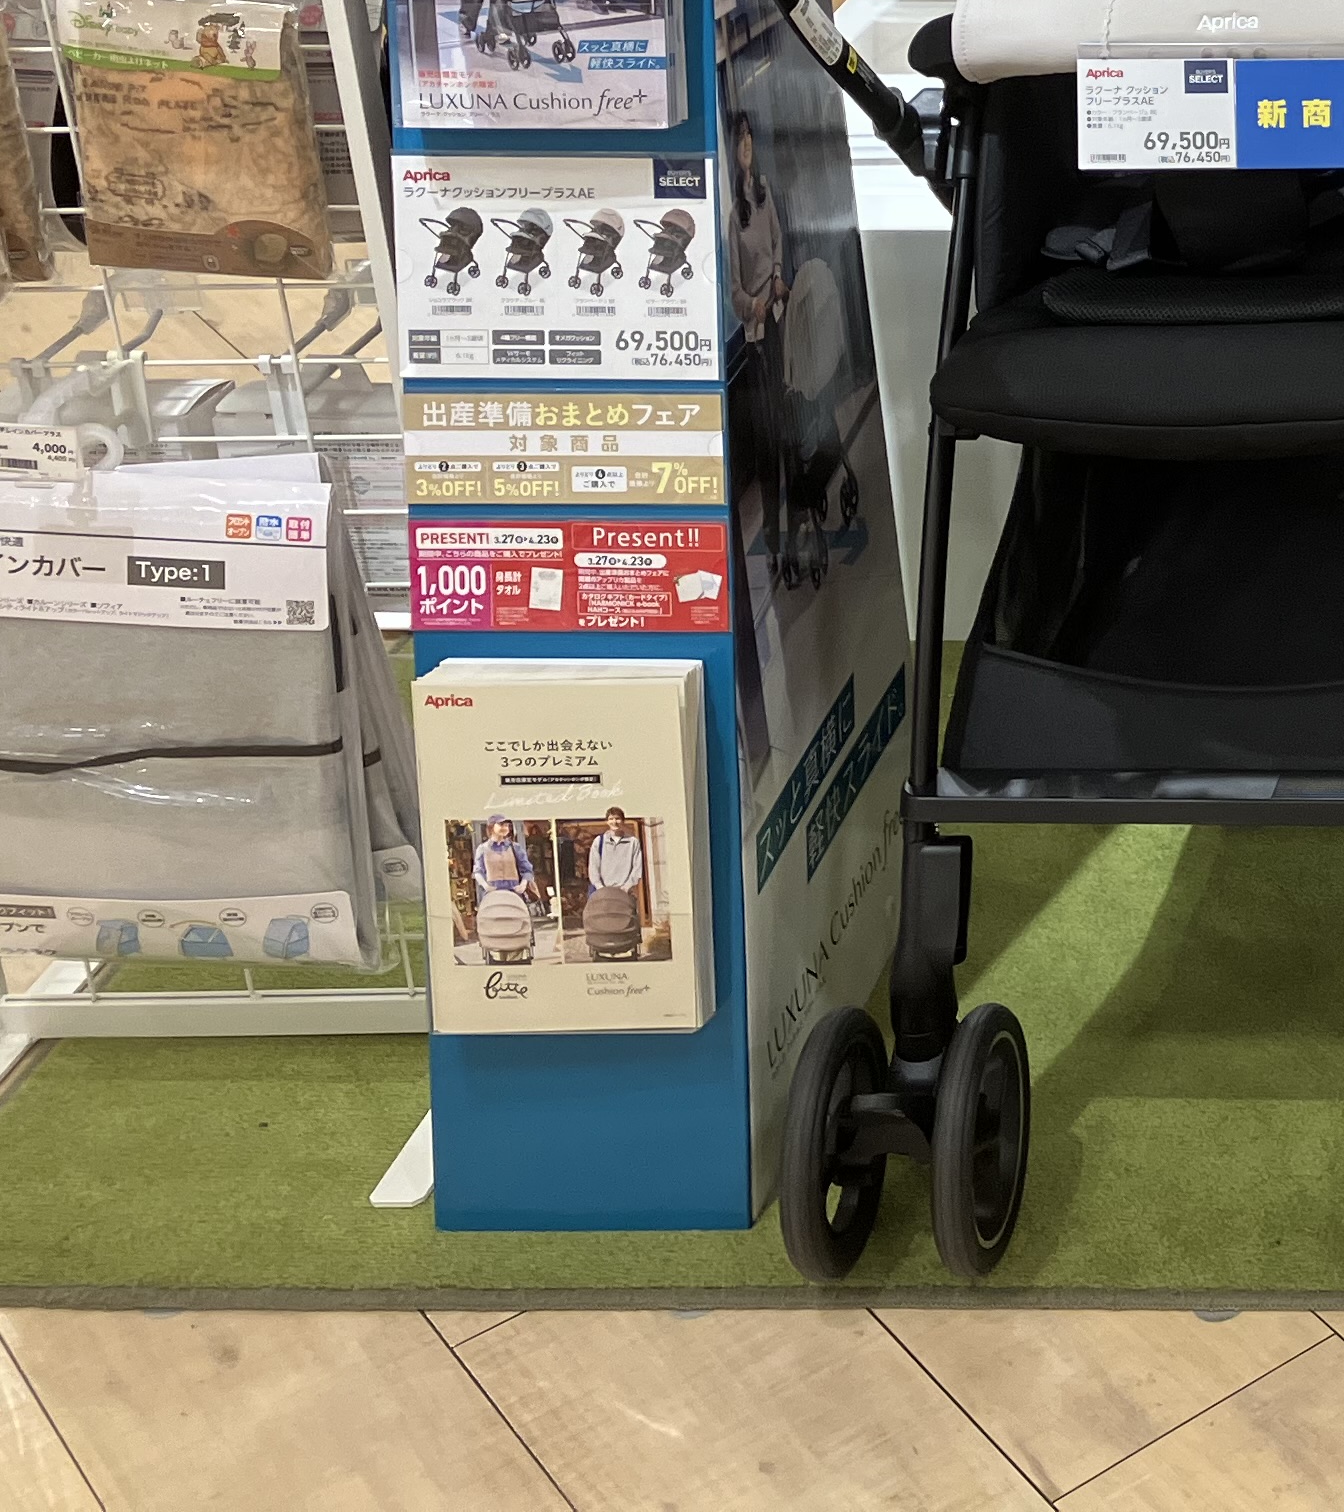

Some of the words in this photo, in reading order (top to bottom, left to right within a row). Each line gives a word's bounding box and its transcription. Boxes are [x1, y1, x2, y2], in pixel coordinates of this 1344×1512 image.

[1196, 12, 1259, 32] Aprica
[578, 40, 646, 54] スッと真横に
[1086, 67, 1124, 80] Aprica
[1189, 74, 1224, 84] SELECT
[1086, 85, 1121, 95] ラクーナ
[1125, 85, 1169, 95] クッション
[419, 92, 508, 110] LUXUNA
[512, 92, 593, 110] Cushion
[1143, 131, 1230, 151] 69,500円
[402, 168, 451, 184] Aprica
[658, 176, 701, 188] SELECT
[403, 186, 595, 200] ラクーナクッションフリープラスAE
[615, 330, 712, 353] 69,500円
[422, 401, 701, 428] 出産準備おまとめフェア
[509, 434, 619, 453] 対象商品
[416, 479, 482, 497] 3%OFF!
[493, 478, 560, 497] 5%OFF!
[583, 480, 616, 488] ご購入で
[674, 476, 717, 494] OFF!
[421, 532, 489, 545] PRESENT!
[593, 527, 699, 548] Present!!
[136, 561, 211, 582] Type:1
[495, 571, 522, 582] 身長計
[417, 565, 486, 596] 1,000
[496, 585, 521, 596] タオル
[420, 598, 484, 615] ポイント
[424, 694, 473, 709] Aprica
[484, 739, 613, 752] ここでしか出会えない
[501, 755, 599, 768] 3つのプレミアム
[766, 939, 829, 1069] LUXUNA
[829, 850, 883, 946] Cushion
